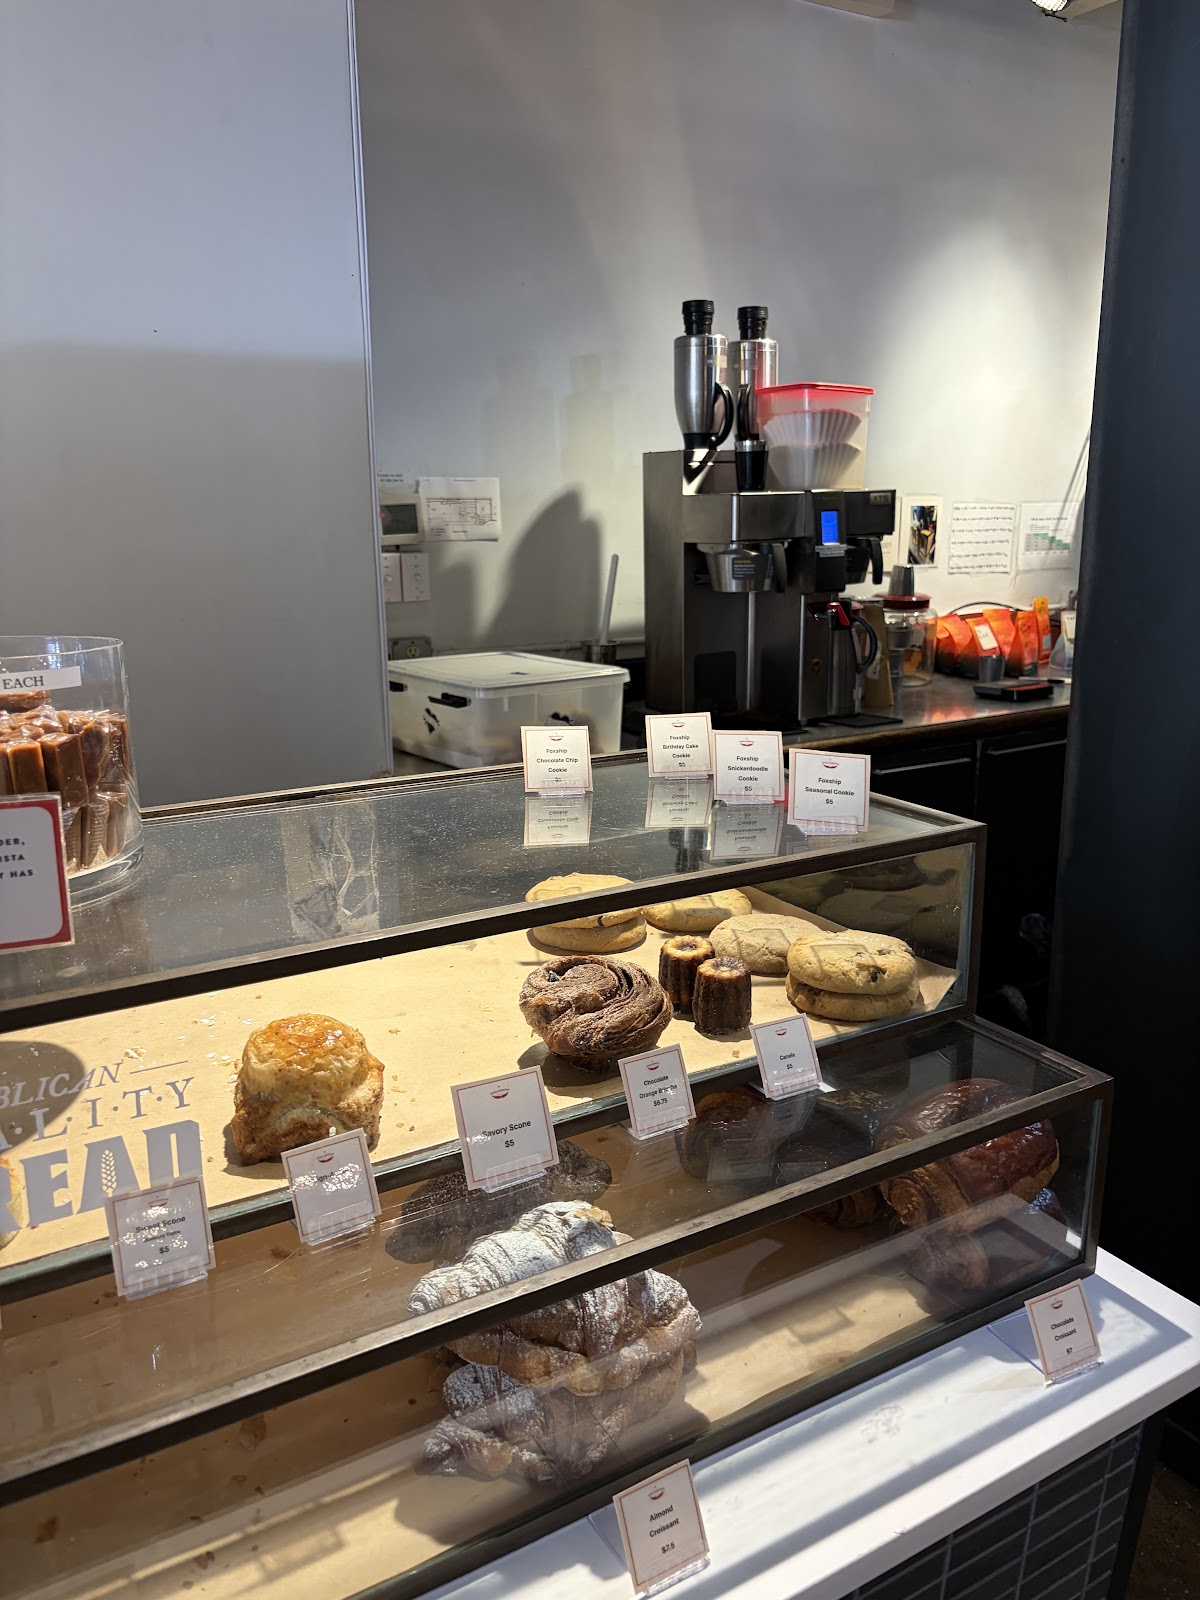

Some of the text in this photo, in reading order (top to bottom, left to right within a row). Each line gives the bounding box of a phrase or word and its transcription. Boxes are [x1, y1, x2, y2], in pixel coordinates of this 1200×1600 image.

[2, 676, 44, 690] EACH
[10, 869, 34, 878] HAS
[644, 1076, 668, 1086] Chocolate
[639, 1090, 658, 1099] Orange
[654, 1098, 668, 1106] $6.75
[482, 1120, 531, 1138] Savory Scone
[504, 1139, 514, 1148] $5
[162, 1216, 186, 1226] Scone
[159, 1246, 170, 1254] $5
[1050, 1317, 1074, 1330] Chocolate
[1054, 1328, 1077, 1342] Croissant
[650, 1504, 674, 1522] Almond
[650, 1518, 680, 1537] Croissant
[661, 1542, 676, 1554] $7.5
